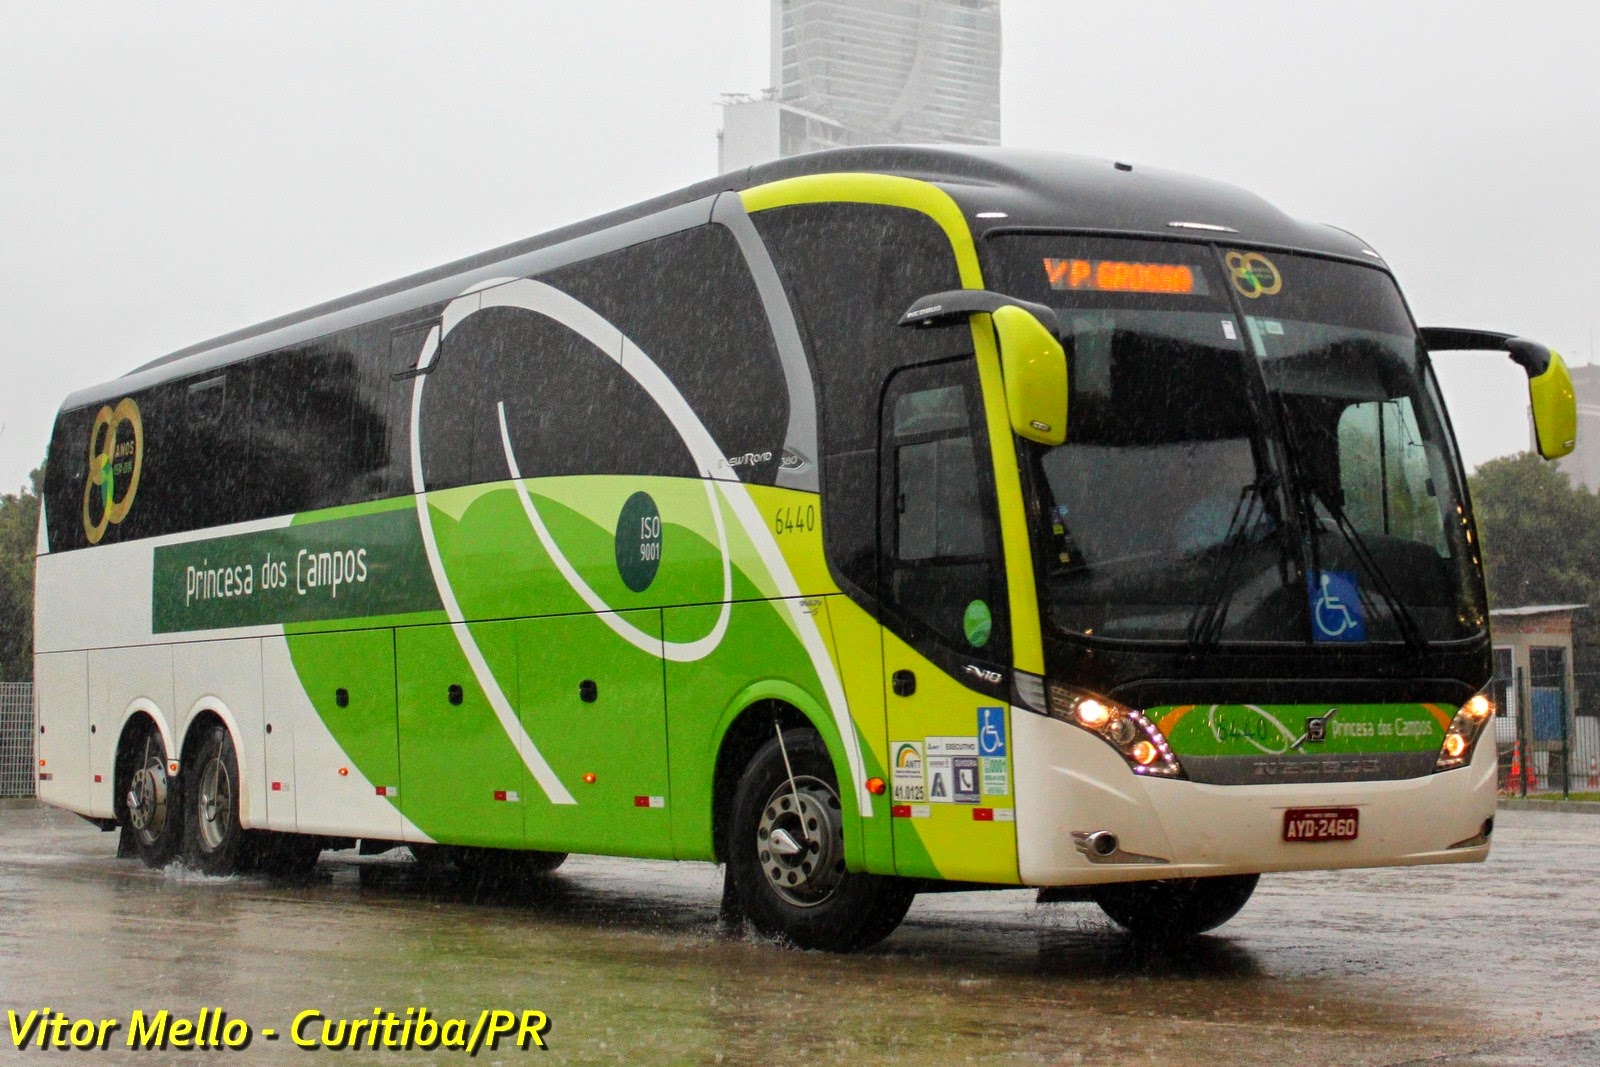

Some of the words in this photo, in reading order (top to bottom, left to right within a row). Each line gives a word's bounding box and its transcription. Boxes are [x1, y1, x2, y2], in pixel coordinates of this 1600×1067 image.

[640, 515, 660, 540] ISO
[775, 504, 815, 535] 6440
[640, 542, 660, 561] 9001
[186, 558, 254, 607] Princesa
[261, 552, 288, 590] dos
[297, 548, 368, 599] Campos
[1331, 719, 1375, 738] Princesa
[1378, 719, 1393, 736] dos
[1395, 718, 1433, 740] Campos
[1287, 819, 1356, 838] AYD-2460
